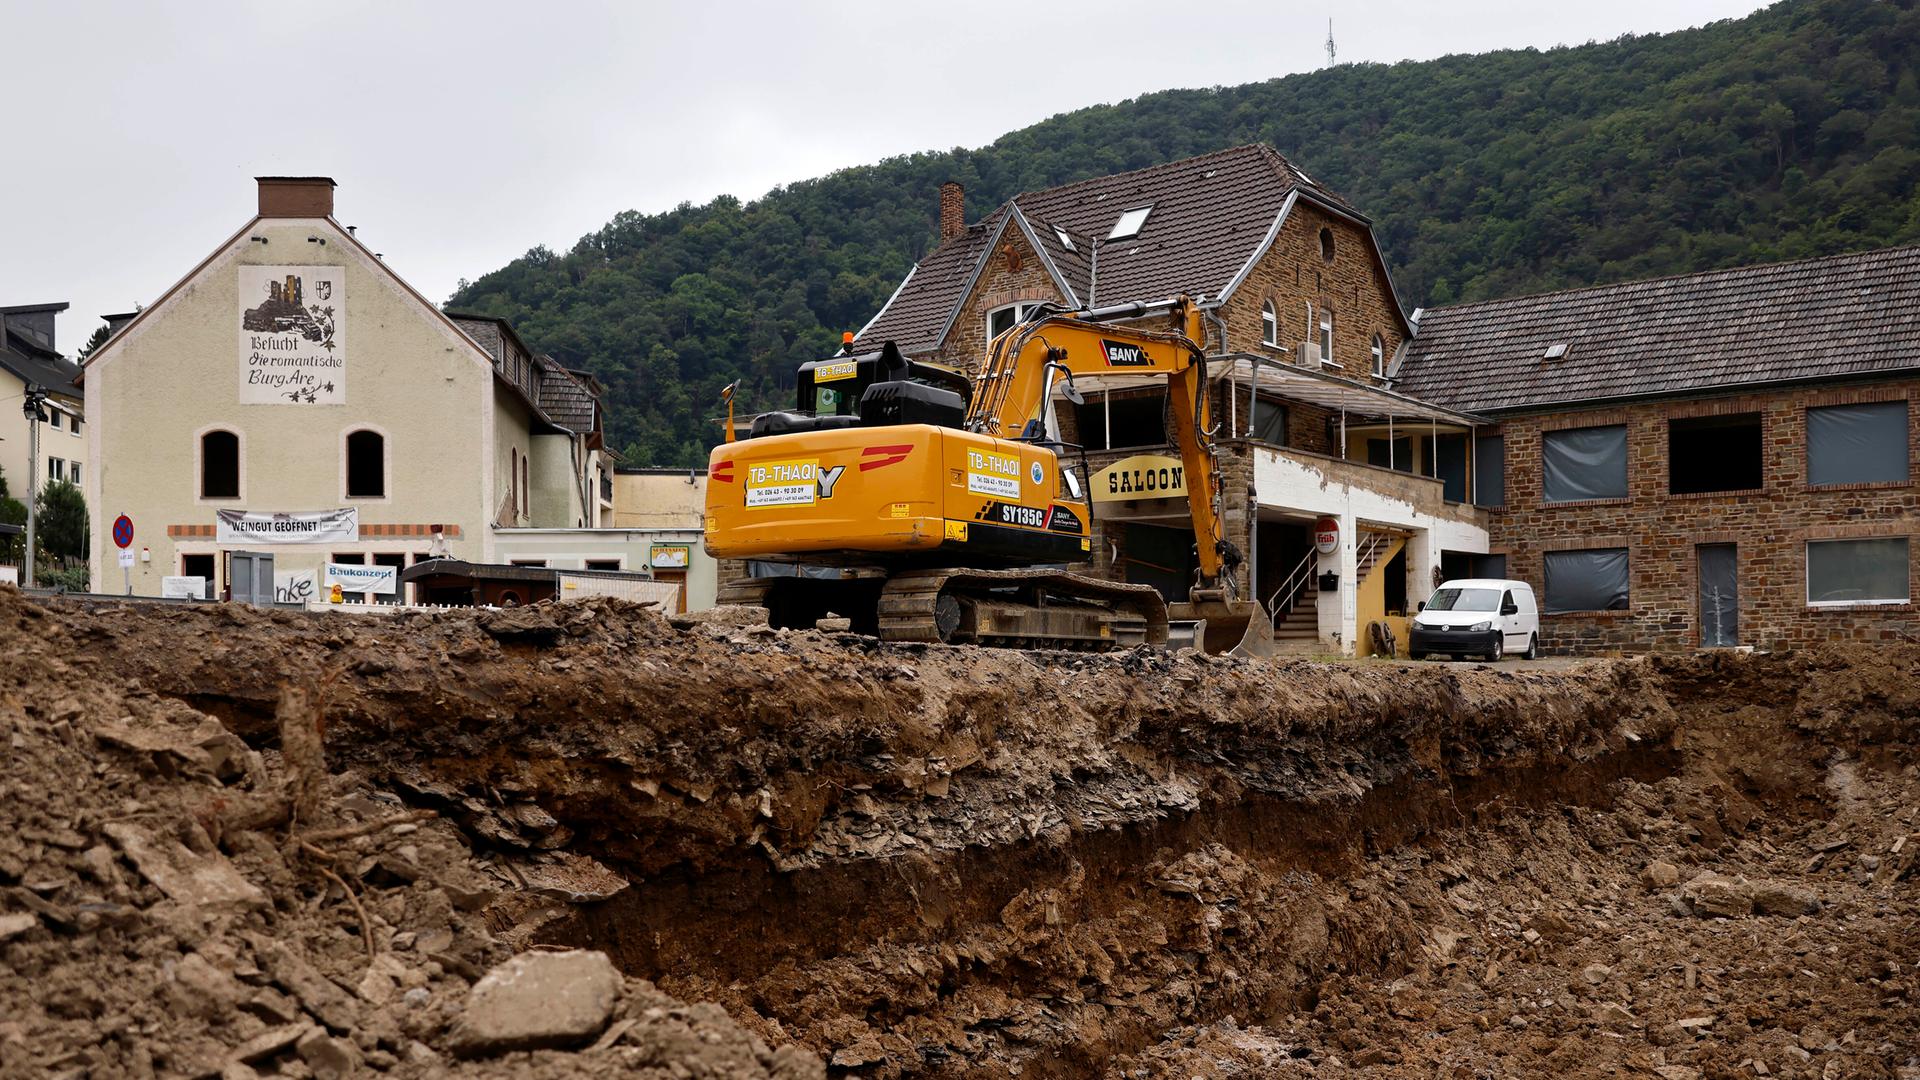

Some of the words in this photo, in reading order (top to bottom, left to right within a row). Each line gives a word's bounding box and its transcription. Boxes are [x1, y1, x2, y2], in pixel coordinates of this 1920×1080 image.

[270, 355, 343, 368] romantische
[1109, 347, 1139, 362] SANY
[816, 364, 855, 377] TB-THAQI
[248, 369, 286, 388] Burg
[286, 369, 315, 385] Are
[969, 451, 1019, 476] TB-THAQI
[749, 463, 817, 484] TB-THAQI
[1109, 467, 1183, 494] SALOON
[1002, 505, 1043, 527] SY135C
[232, 521, 271, 532] WEINGUT
[274, 518, 318, 532] GEÖFFNET
[1318, 533, 1335, 543] früh
[329, 567, 393, 580] Baukonzept
